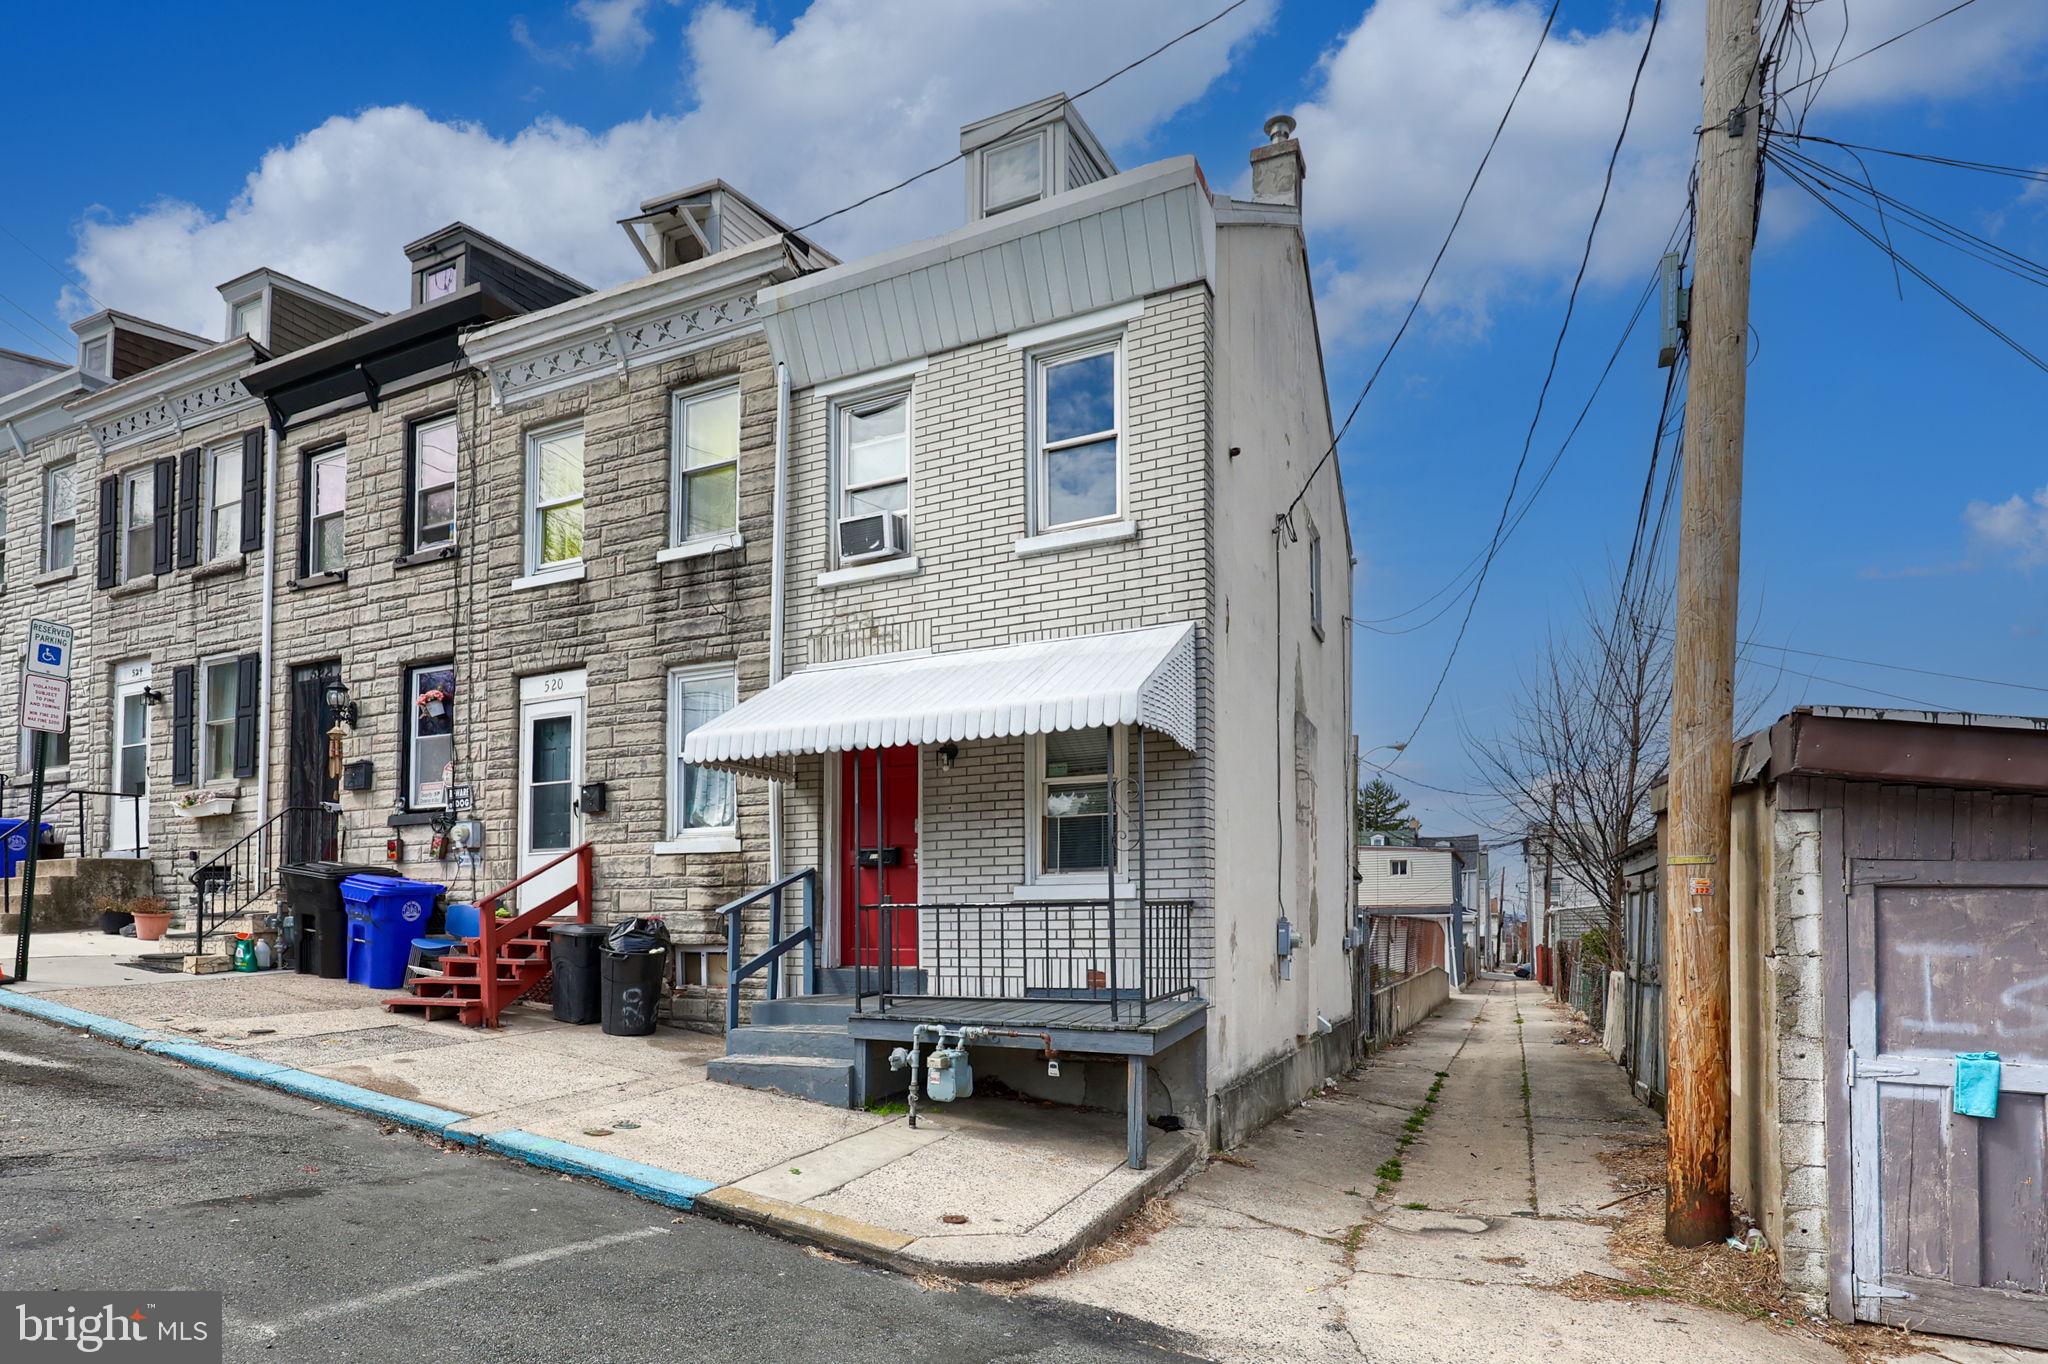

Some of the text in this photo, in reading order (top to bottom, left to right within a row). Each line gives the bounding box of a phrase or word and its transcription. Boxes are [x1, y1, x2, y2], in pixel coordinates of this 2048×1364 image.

[33, 623, 71, 638] RESERVED
[35, 633, 68, 647] PARKING
[132, 666, 143, 677] 524
[33, 682, 61, 692] VIOLATORS
[544, 678, 564, 693] 520
[35, 689, 57, 698] SUBJECT
[42, 702, 60, 710] TOWING
[455, 798, 470, 808] DOG
